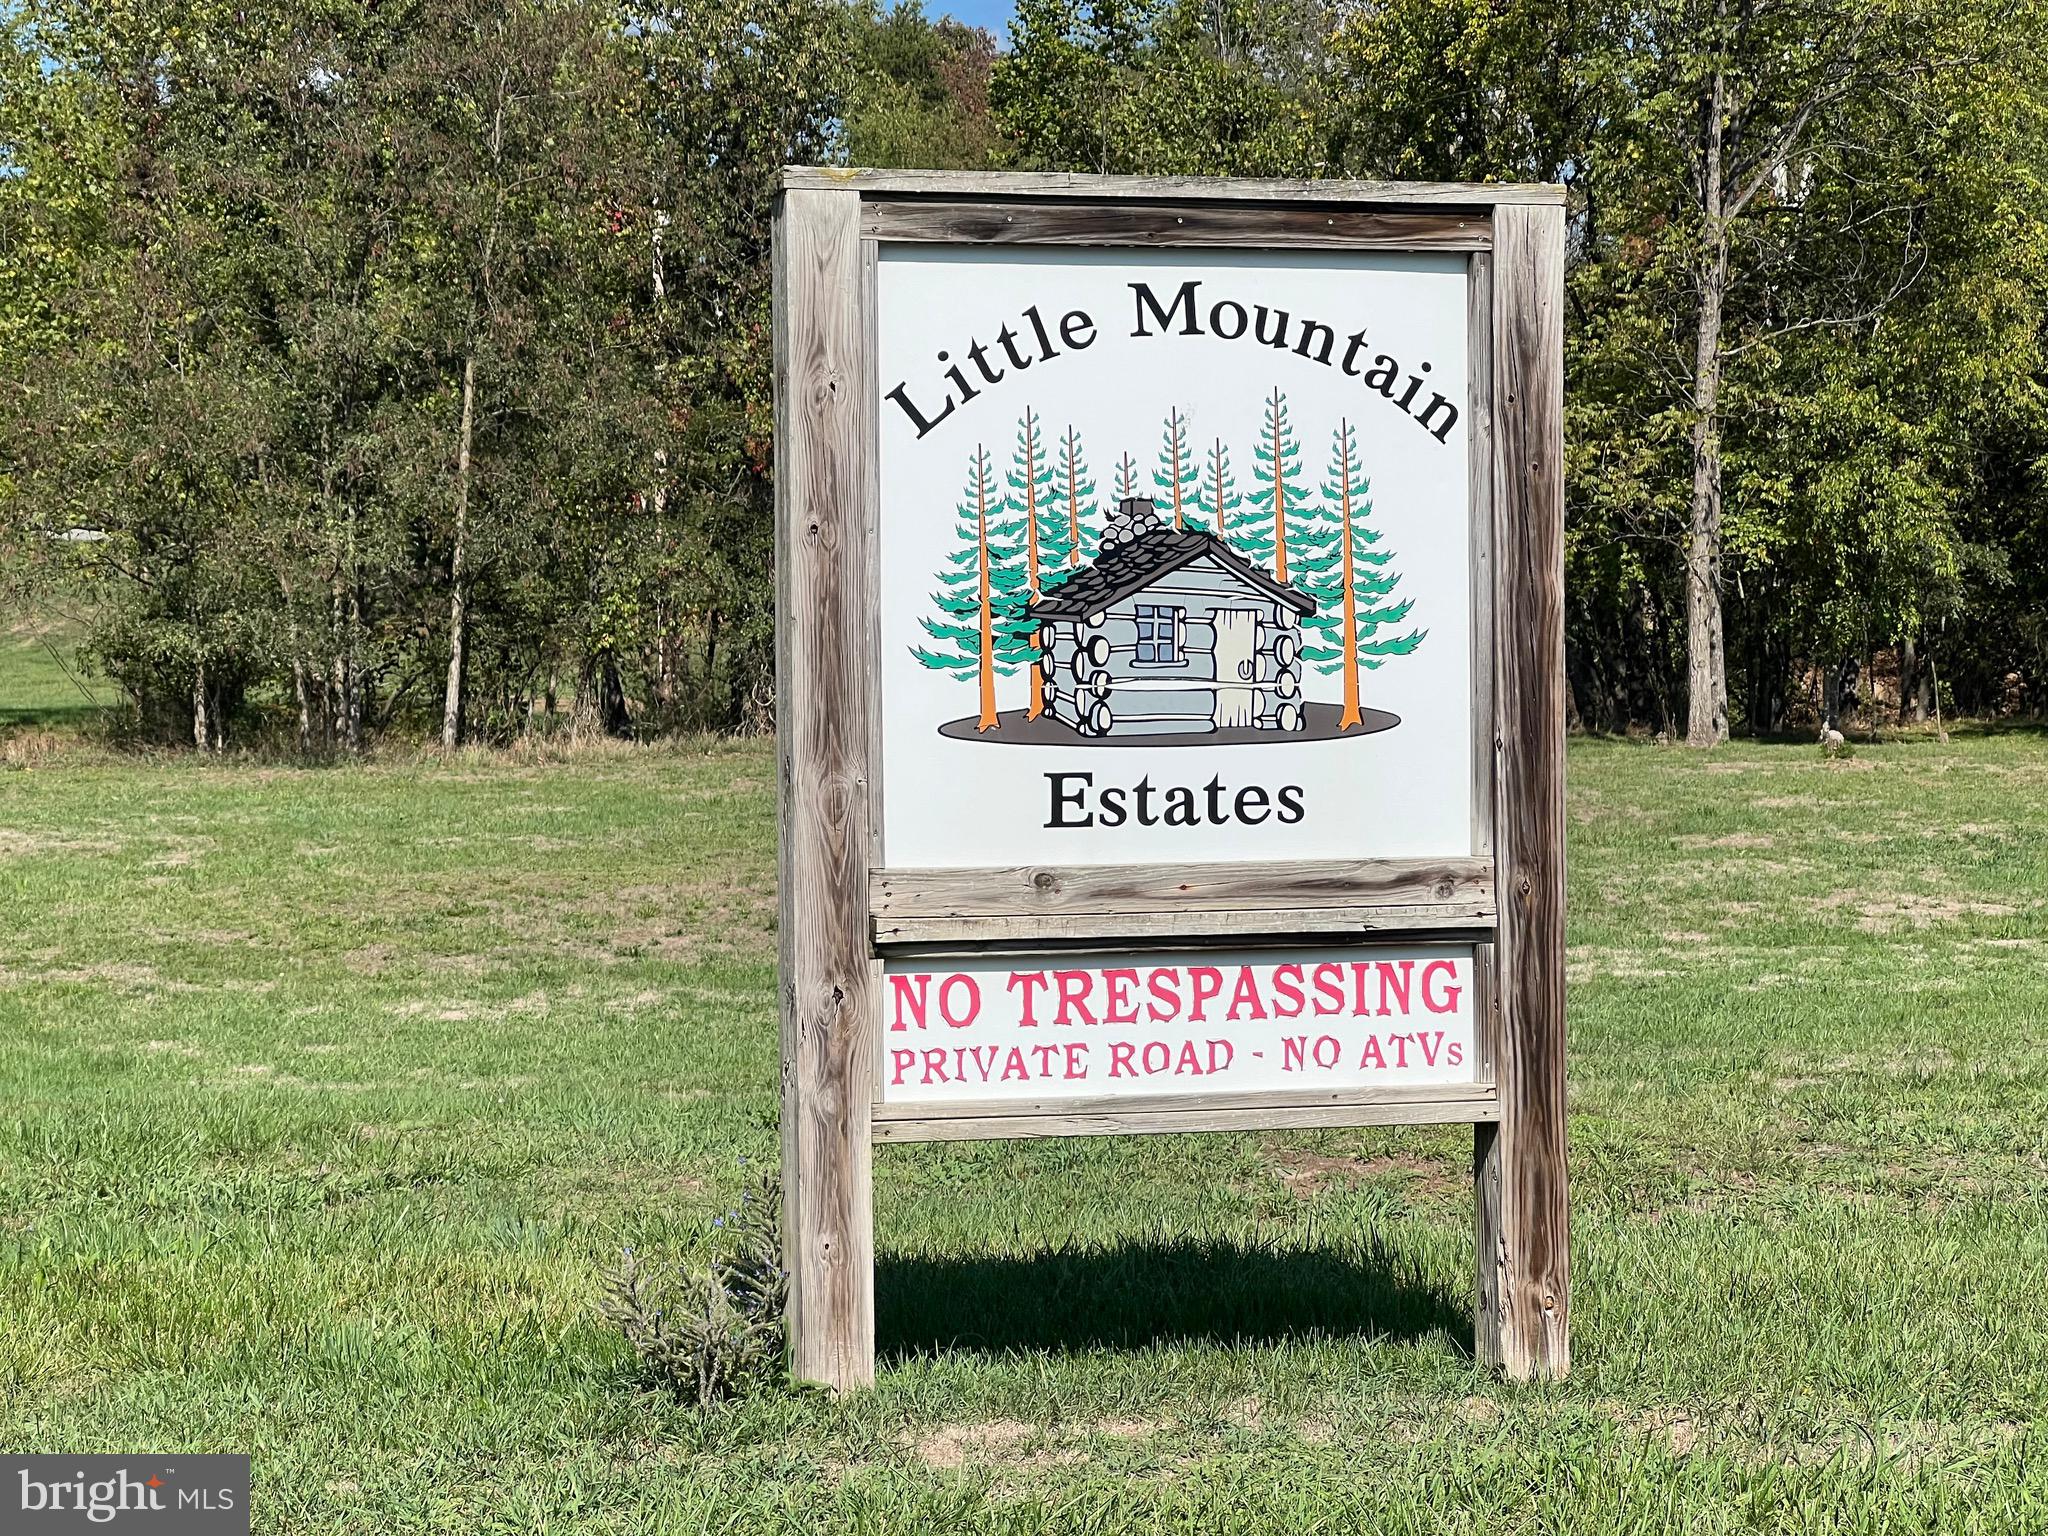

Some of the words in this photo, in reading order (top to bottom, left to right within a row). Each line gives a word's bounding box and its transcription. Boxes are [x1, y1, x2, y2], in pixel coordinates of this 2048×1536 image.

[884, 305, 1098, 441] Little
[1127, 281, 1459, 445] Mountain
[1043, 772, 1306, 830] Estates
[889, 972, 982, 1032] NO
[1006, 960, 1463, 1028] TRESPASSING
[891, 1042, 1090, 1086] PRIVATE
[1108, 1038, 1234, 1078] ROAD
[1282, 1035, 1342, 1072] NO
[1359, 1031, 1464, 1069] ATVs
